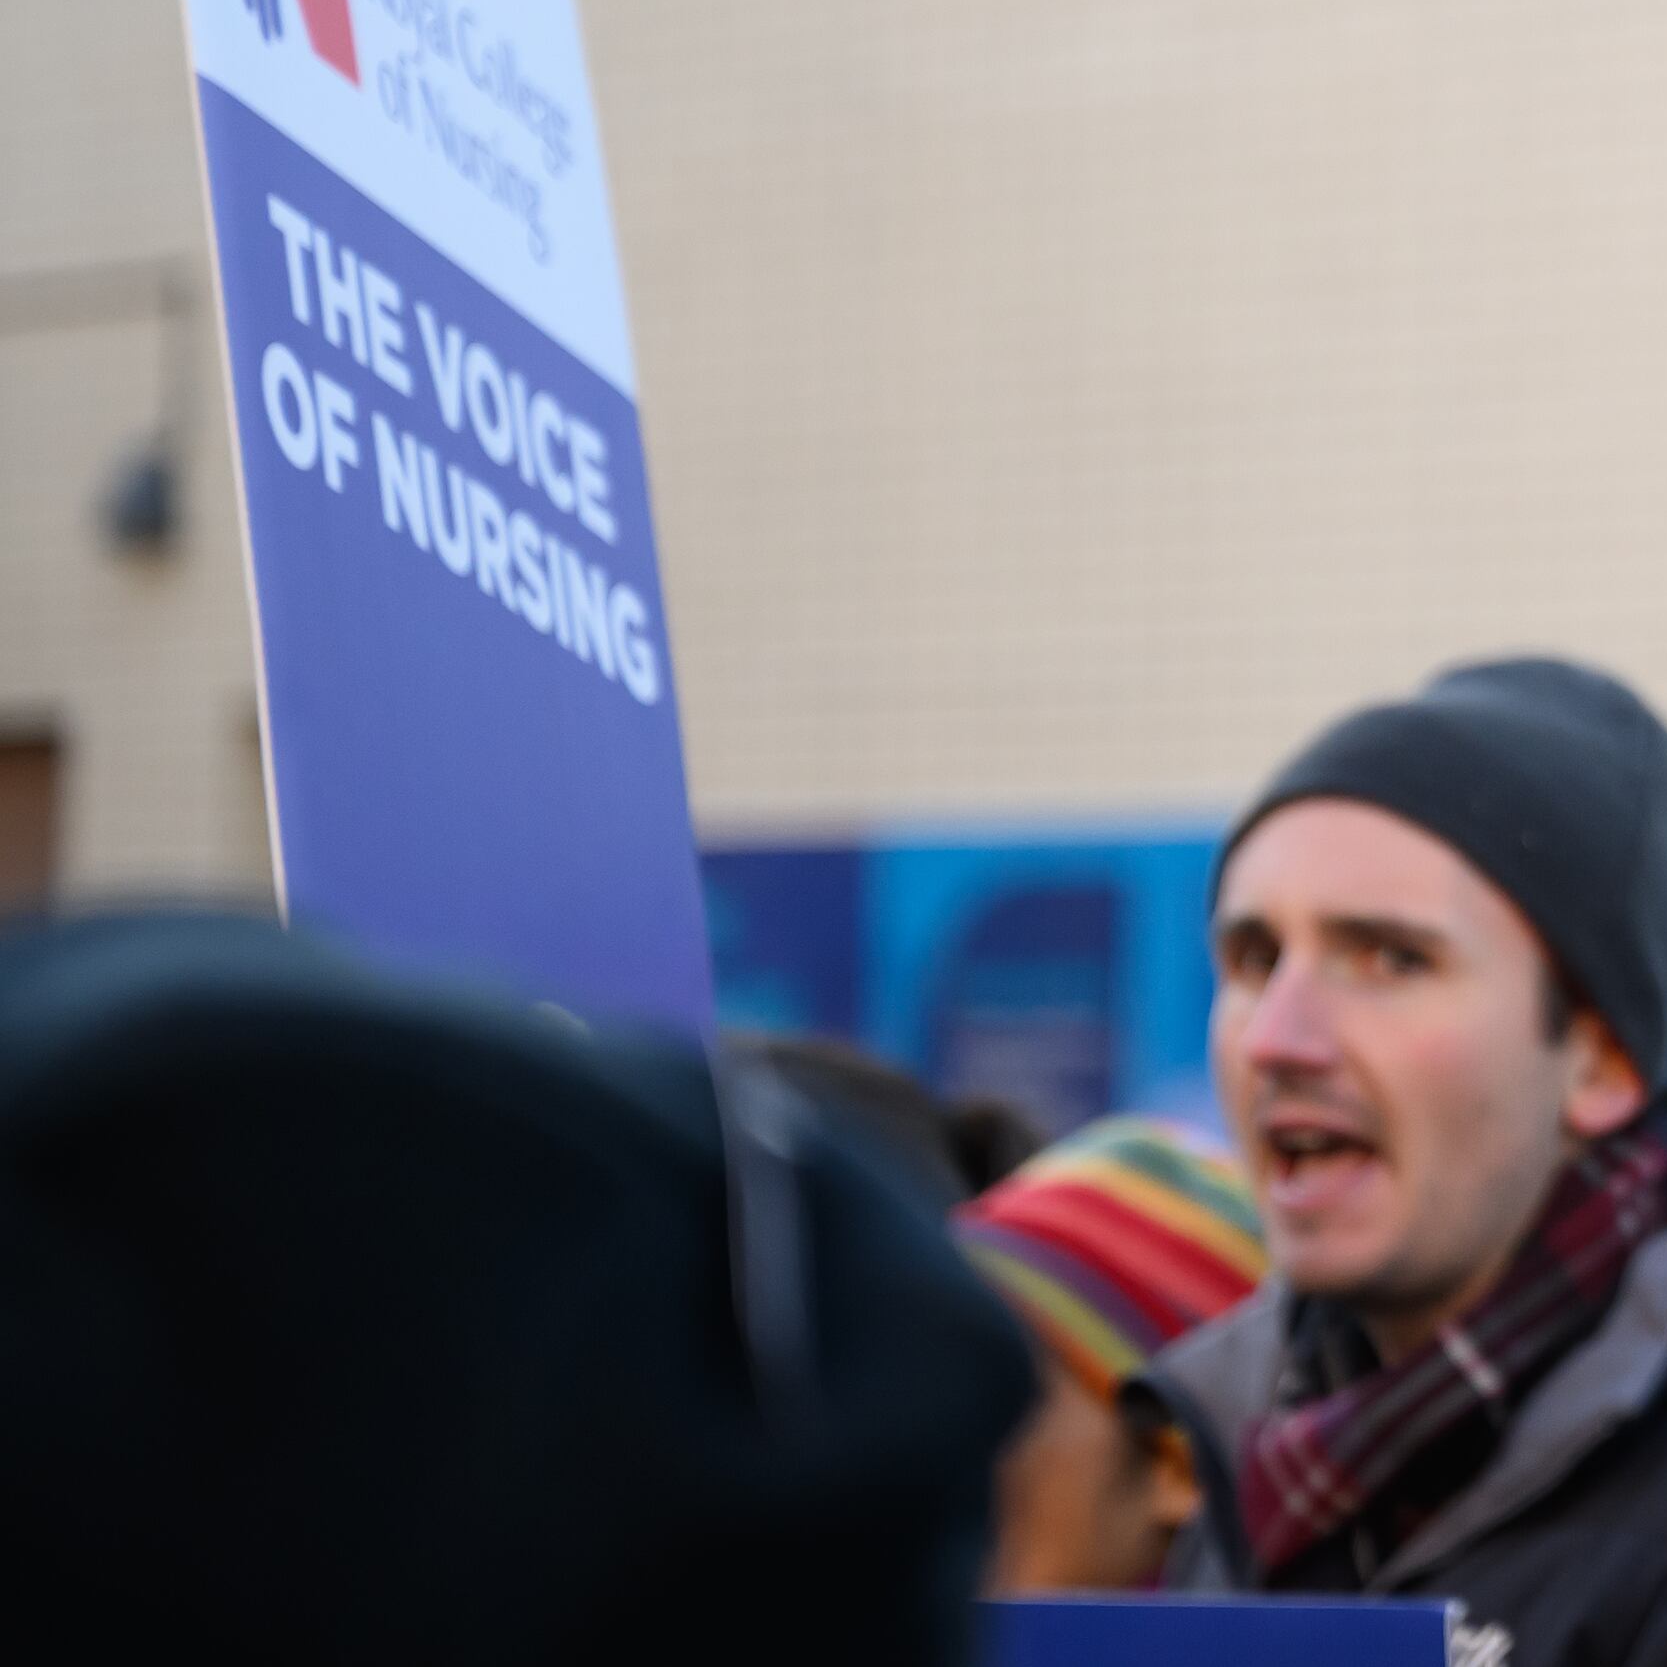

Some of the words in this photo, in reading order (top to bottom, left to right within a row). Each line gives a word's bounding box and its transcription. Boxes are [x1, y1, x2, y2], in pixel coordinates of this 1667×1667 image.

[377, 52, 414, 134] of
[418, 76, 554, 268] Nursing
[456, 6, 575, 180] College
[267, 191, 413, 397] THE
[415, 301, 619, 547] VOICE
[261, 341, 361, 493] OF
[372, 410, 661, 706] NURSING
